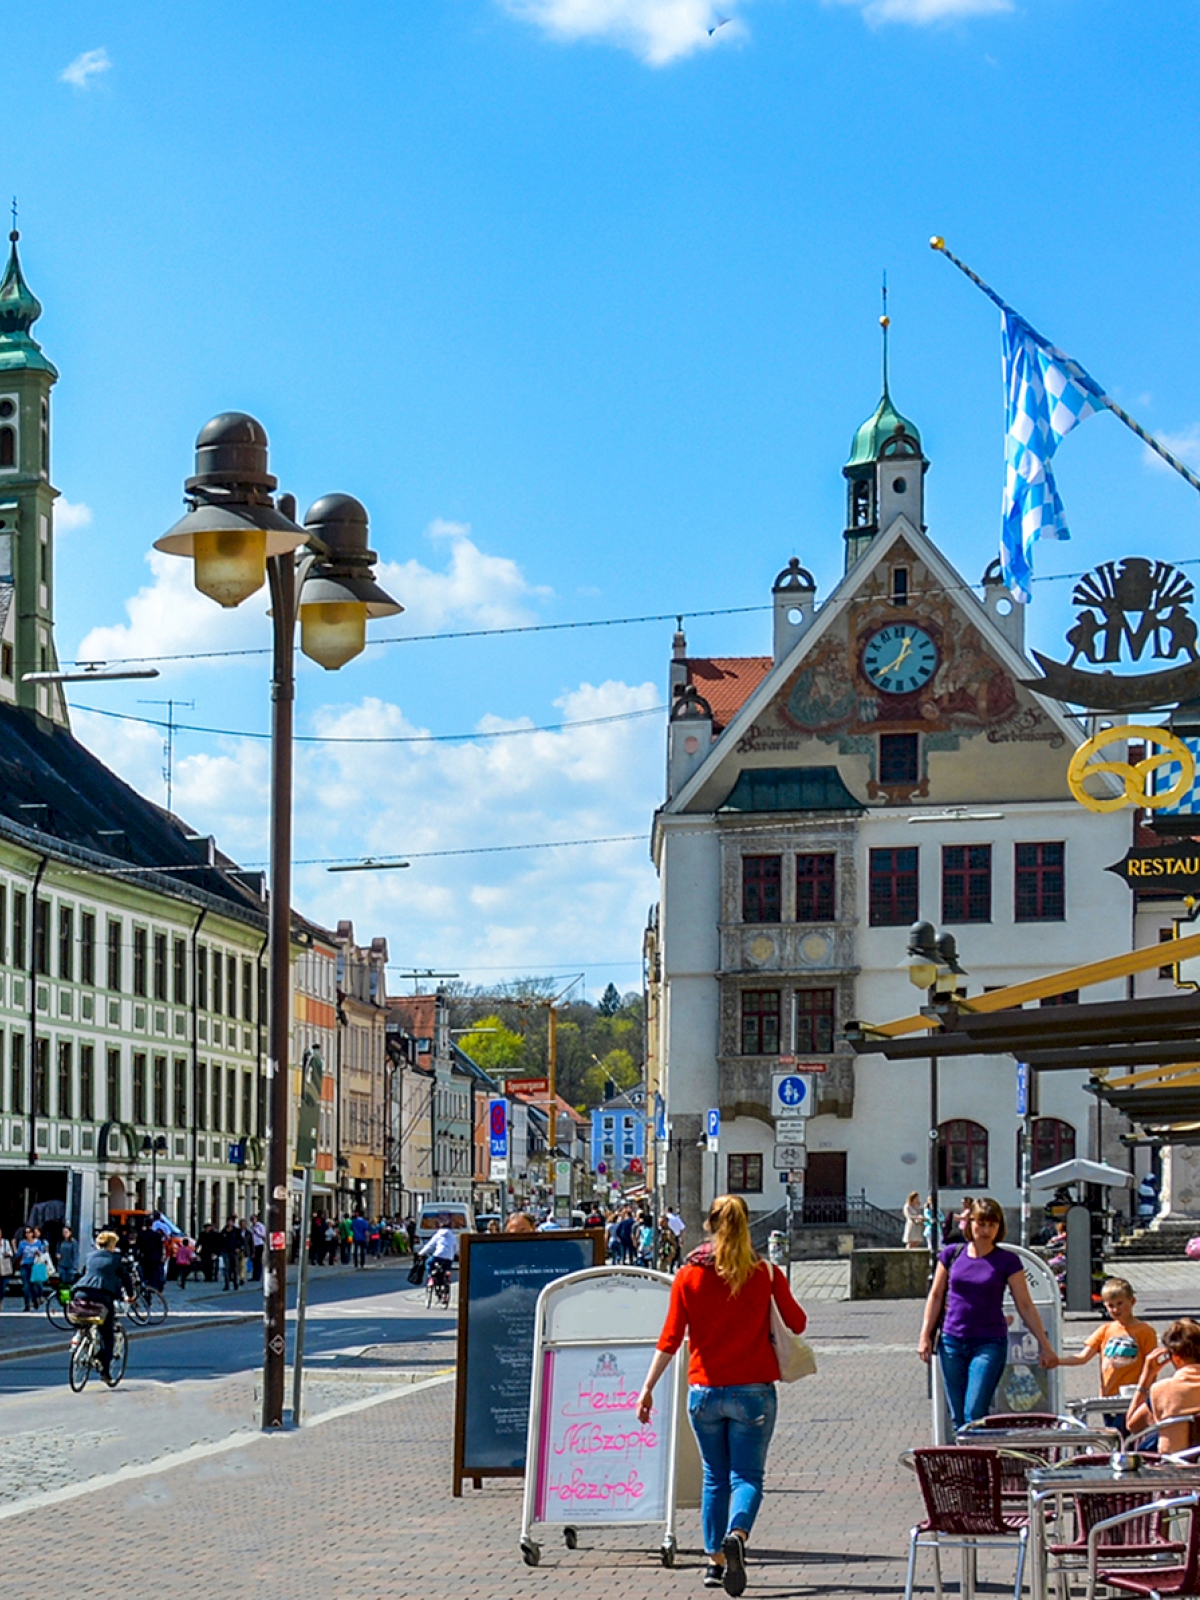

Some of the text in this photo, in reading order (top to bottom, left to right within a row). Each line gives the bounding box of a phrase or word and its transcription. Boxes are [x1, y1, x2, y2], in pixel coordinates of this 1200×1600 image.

[1128, 857, 1200, 876] RESTAU
[710, 1113, 717, 1134] P
[578, 1376, 640, 1409] Heute
